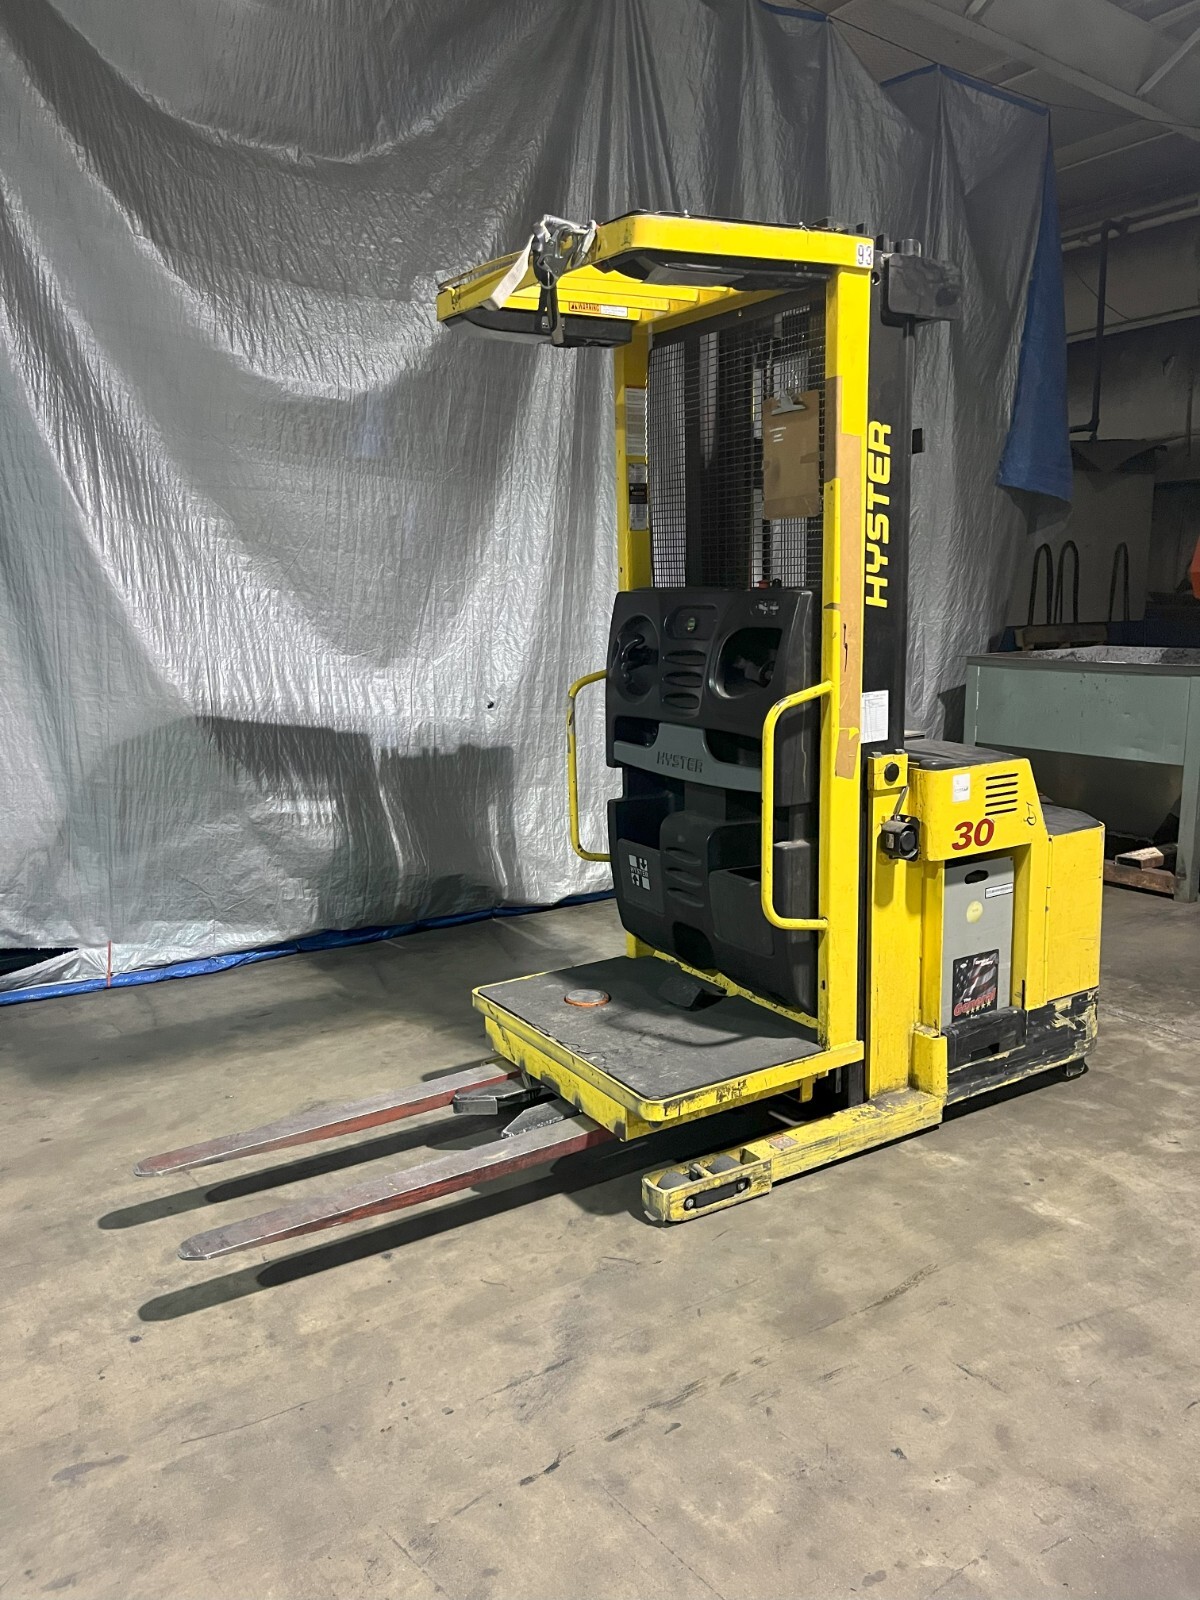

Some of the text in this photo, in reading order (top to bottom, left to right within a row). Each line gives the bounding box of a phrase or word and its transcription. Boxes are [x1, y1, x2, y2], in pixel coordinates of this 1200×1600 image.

[858, 244, 872, 266] 93
[865, 420, 892, 609] HYSTER
[656, 751, 703, 773] HYSTER
[951, 818, 995, 851] 30
[954, 987, 997, 1016] General
